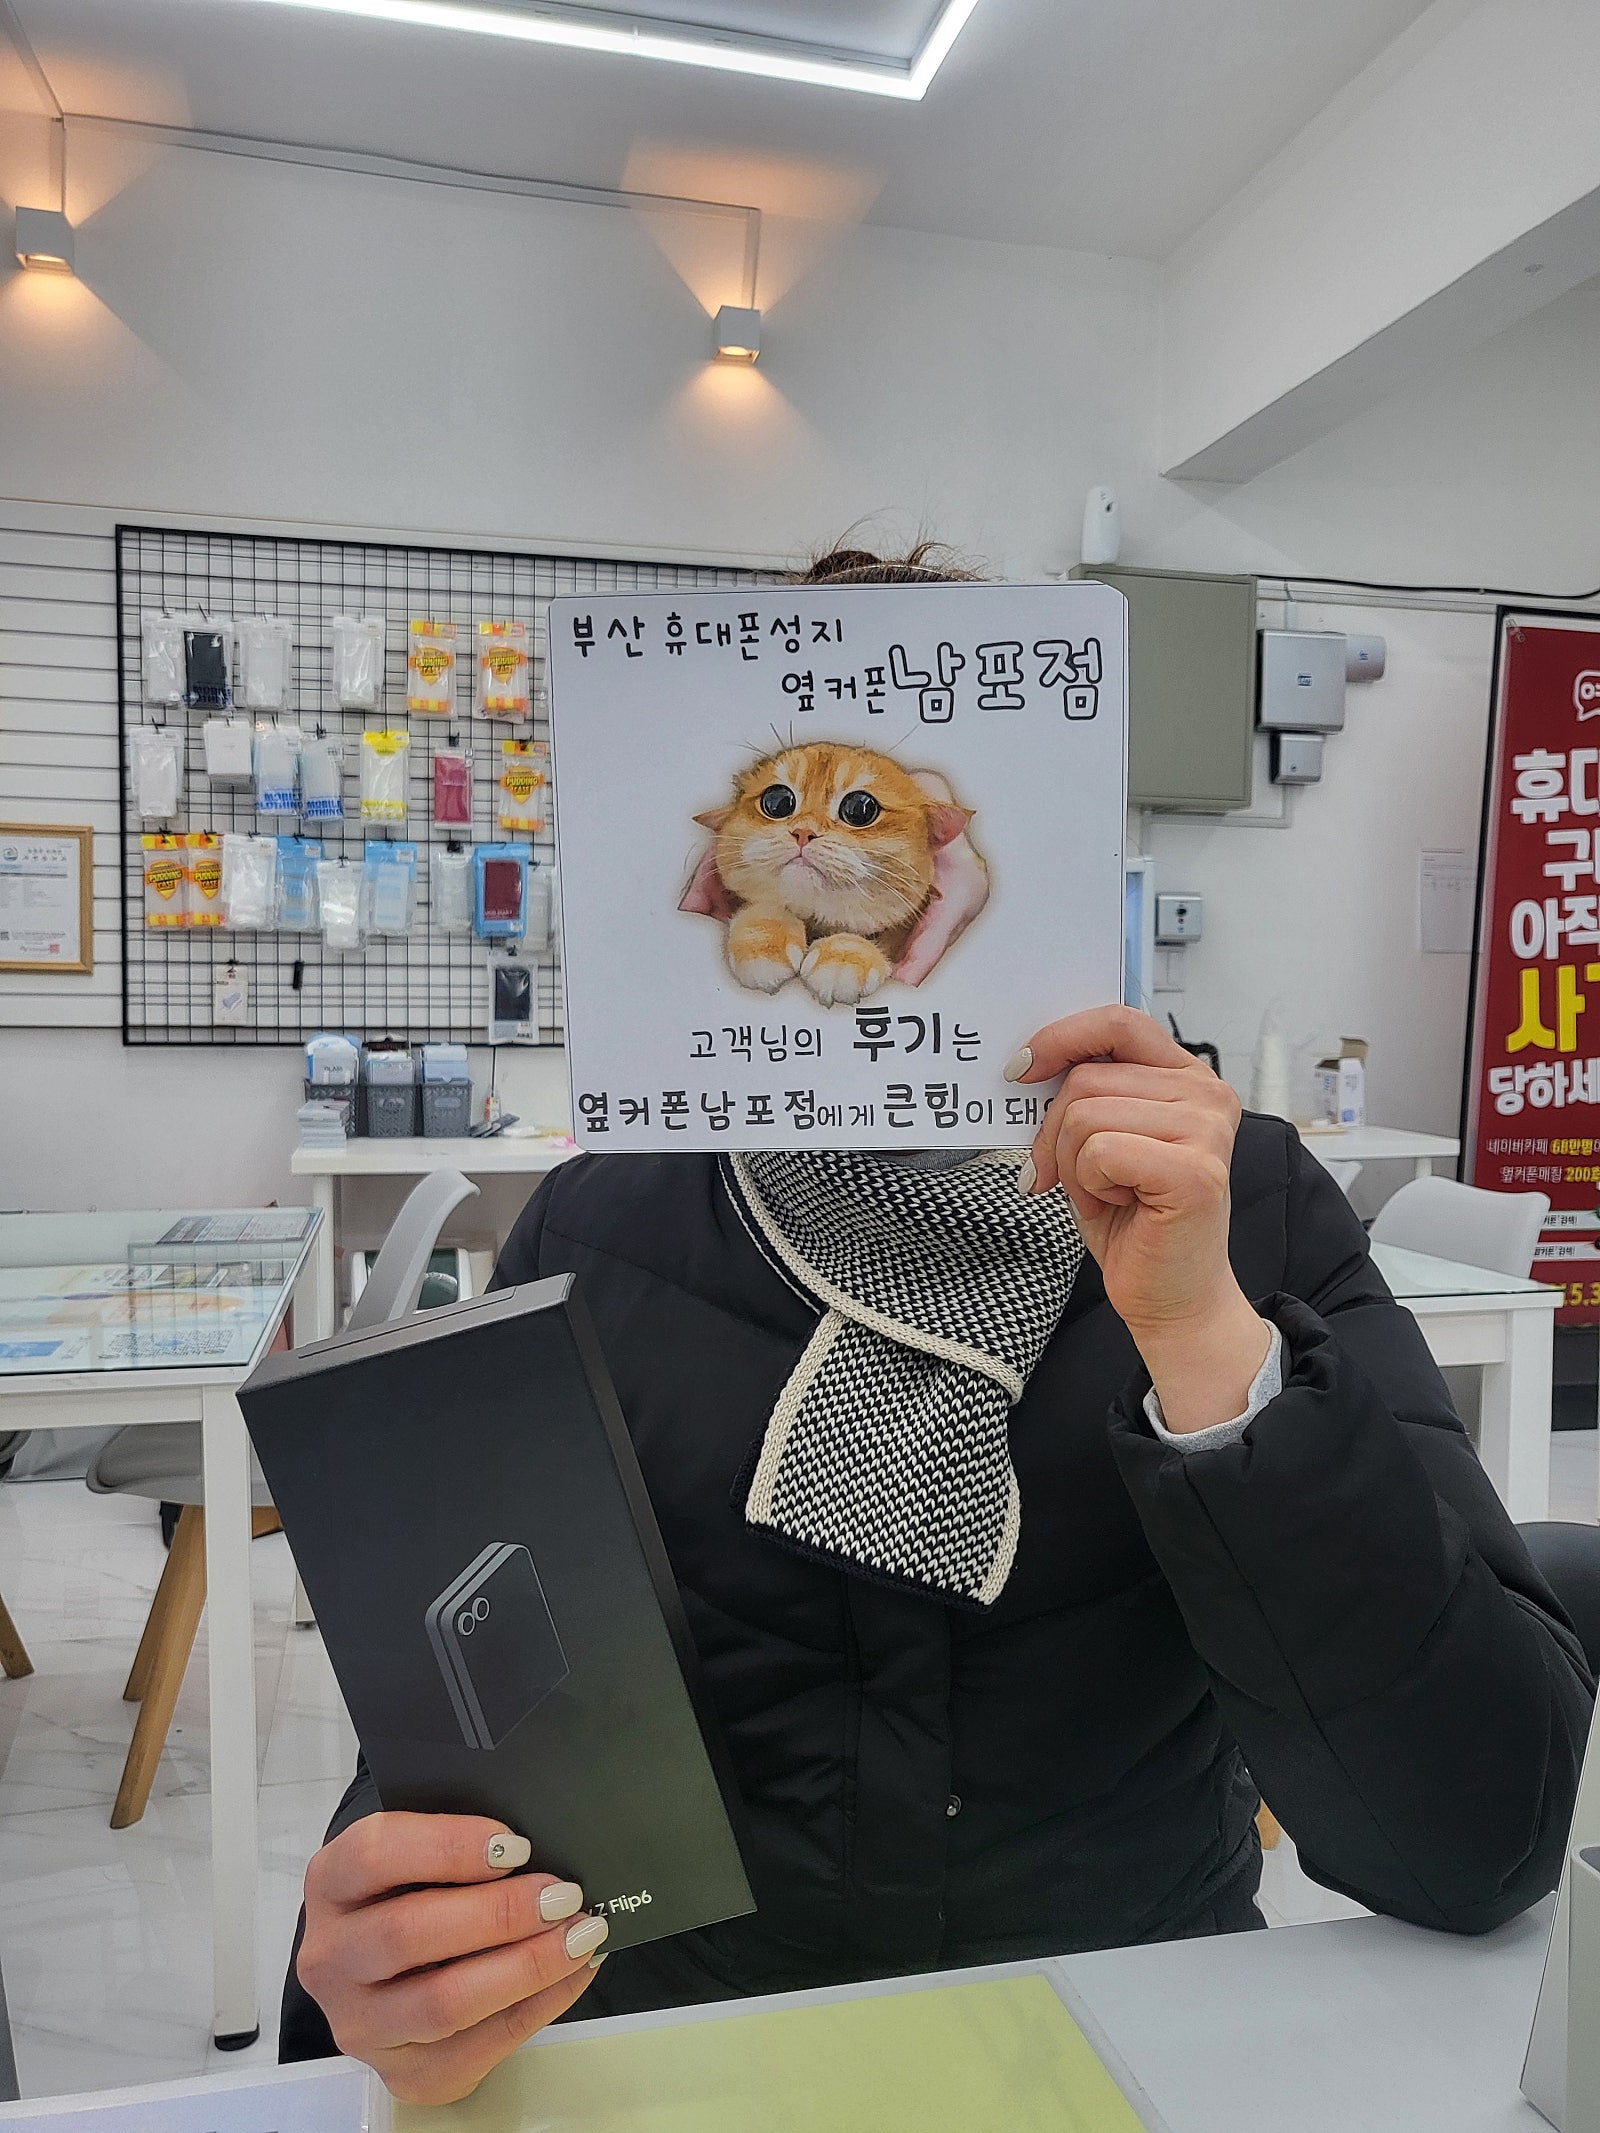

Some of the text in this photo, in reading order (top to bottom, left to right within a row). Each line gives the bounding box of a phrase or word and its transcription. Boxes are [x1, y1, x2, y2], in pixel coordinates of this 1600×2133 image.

[1542, 827, 1600, 891] 구
[689, 1005, 982, 1062] 고객님의 후기는
[1506, 962, 1600, 1053] 사
[1005, 1096, 1055, 1126] 돼
[609, 1890, 653, 1914] Flip6
